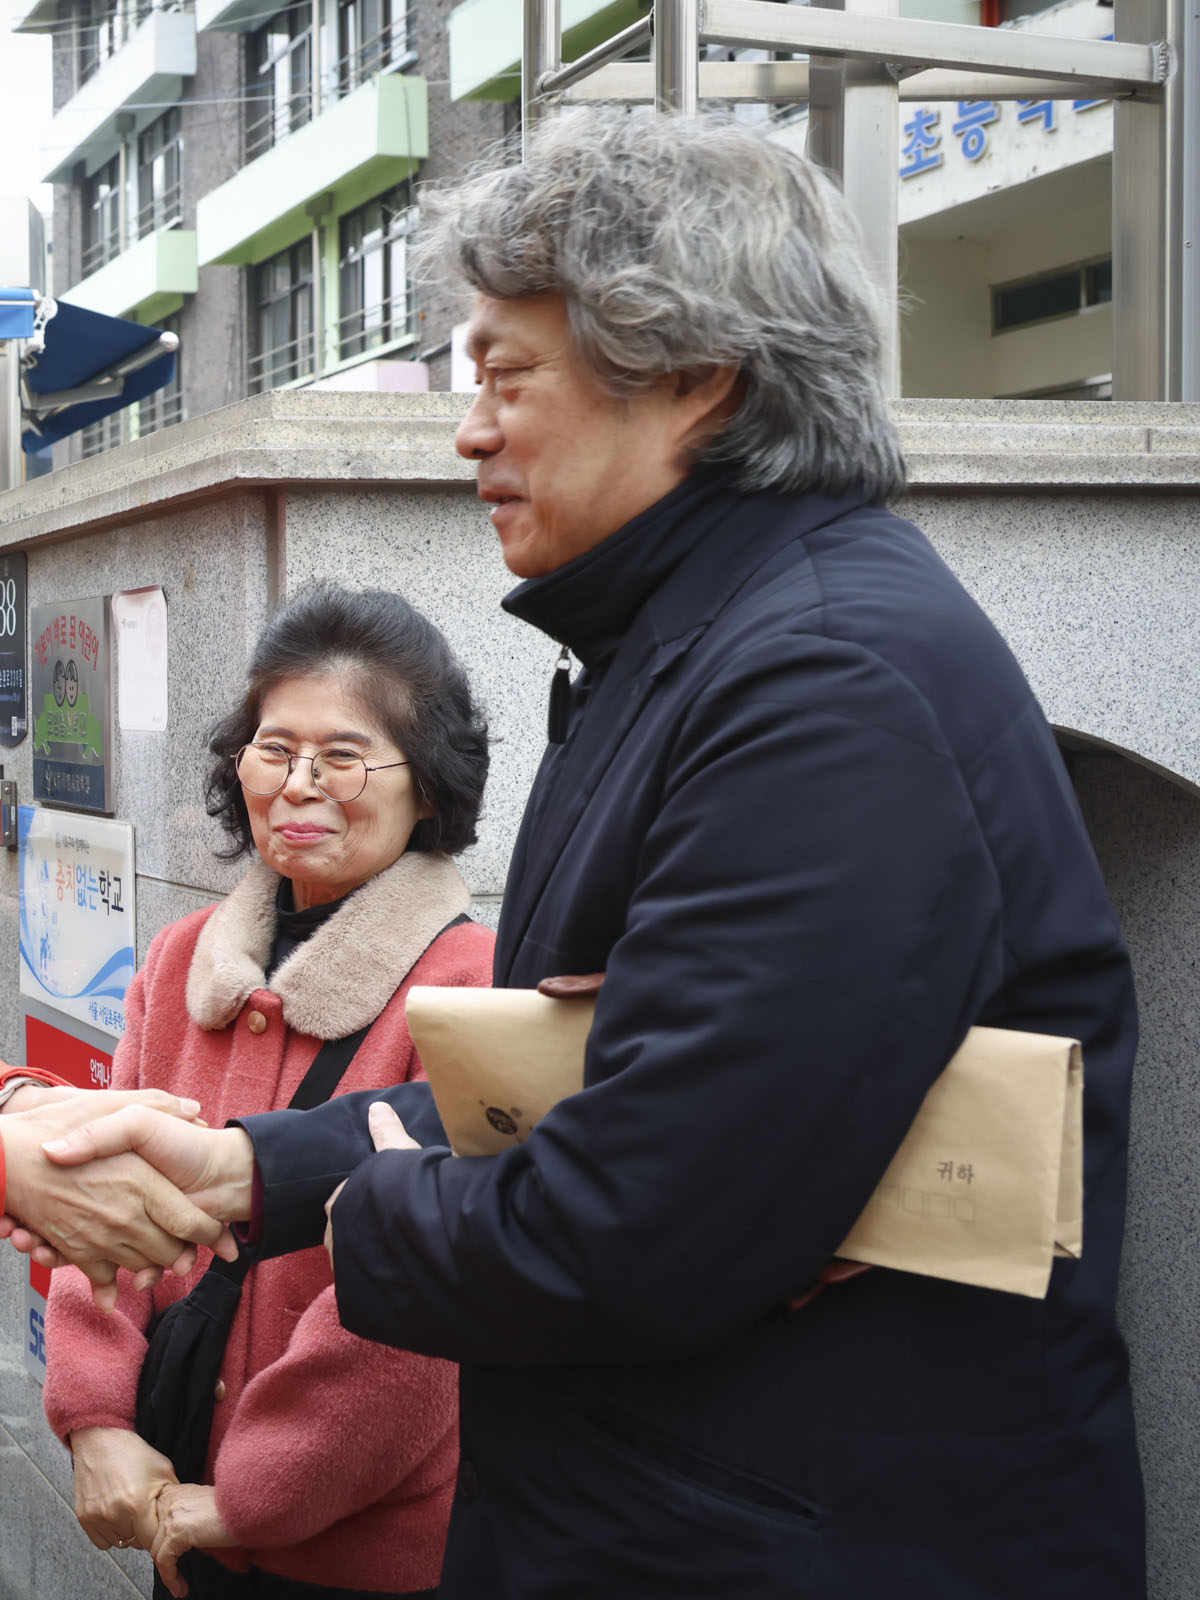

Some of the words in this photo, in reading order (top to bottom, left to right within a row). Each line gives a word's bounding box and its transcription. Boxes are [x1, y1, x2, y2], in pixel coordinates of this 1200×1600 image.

[78, 620, 99, 672] 어린이
[88, 1000, 98, 1021] 서울
[936, 1160, 976, 1185] 귀하
